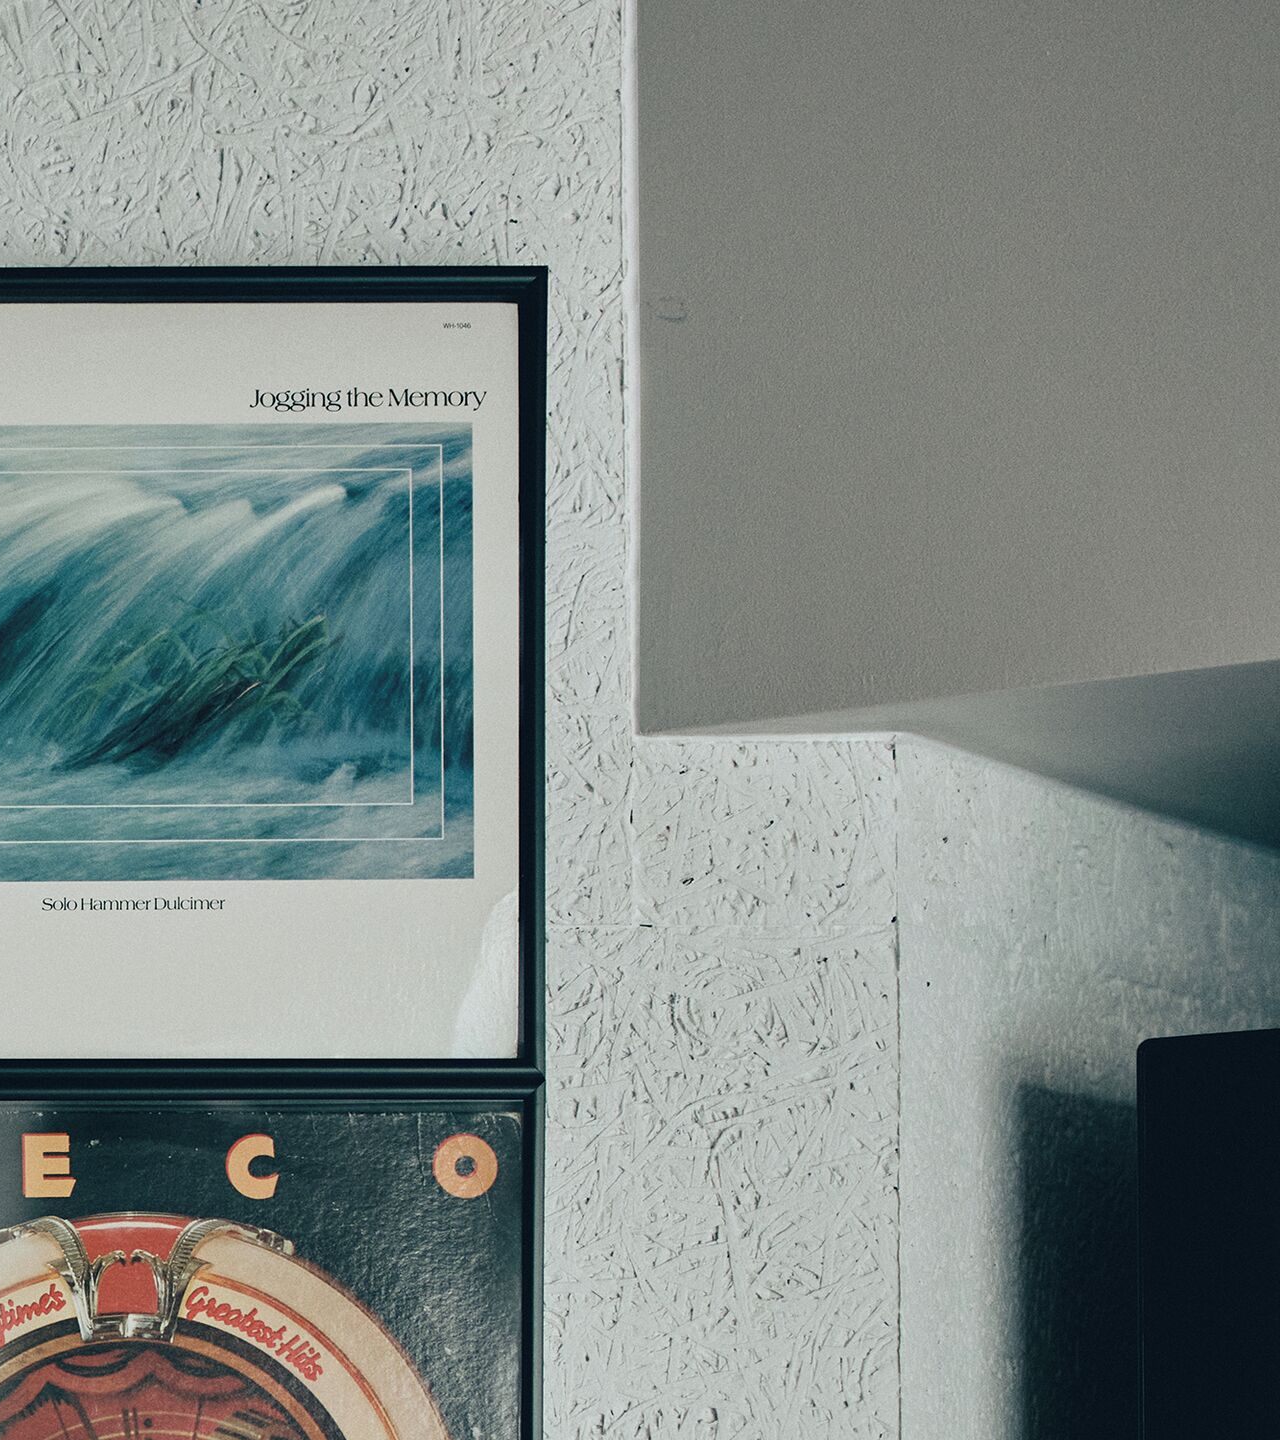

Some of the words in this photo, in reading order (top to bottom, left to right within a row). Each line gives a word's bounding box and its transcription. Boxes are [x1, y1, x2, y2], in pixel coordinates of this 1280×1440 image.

[249, 388, 342, 412] Jogging
[346, 386, 384, 408] the
[388, 388, 487, 412] Memory
[41, 897, 85, 912] Solo
[89, 897, 158, 911] Hammer
[161, 896, 226, 911] Dulcimer
[184, 1285, 287, 1350] Greatest
[275, 1334, 325, 1382] Hits
